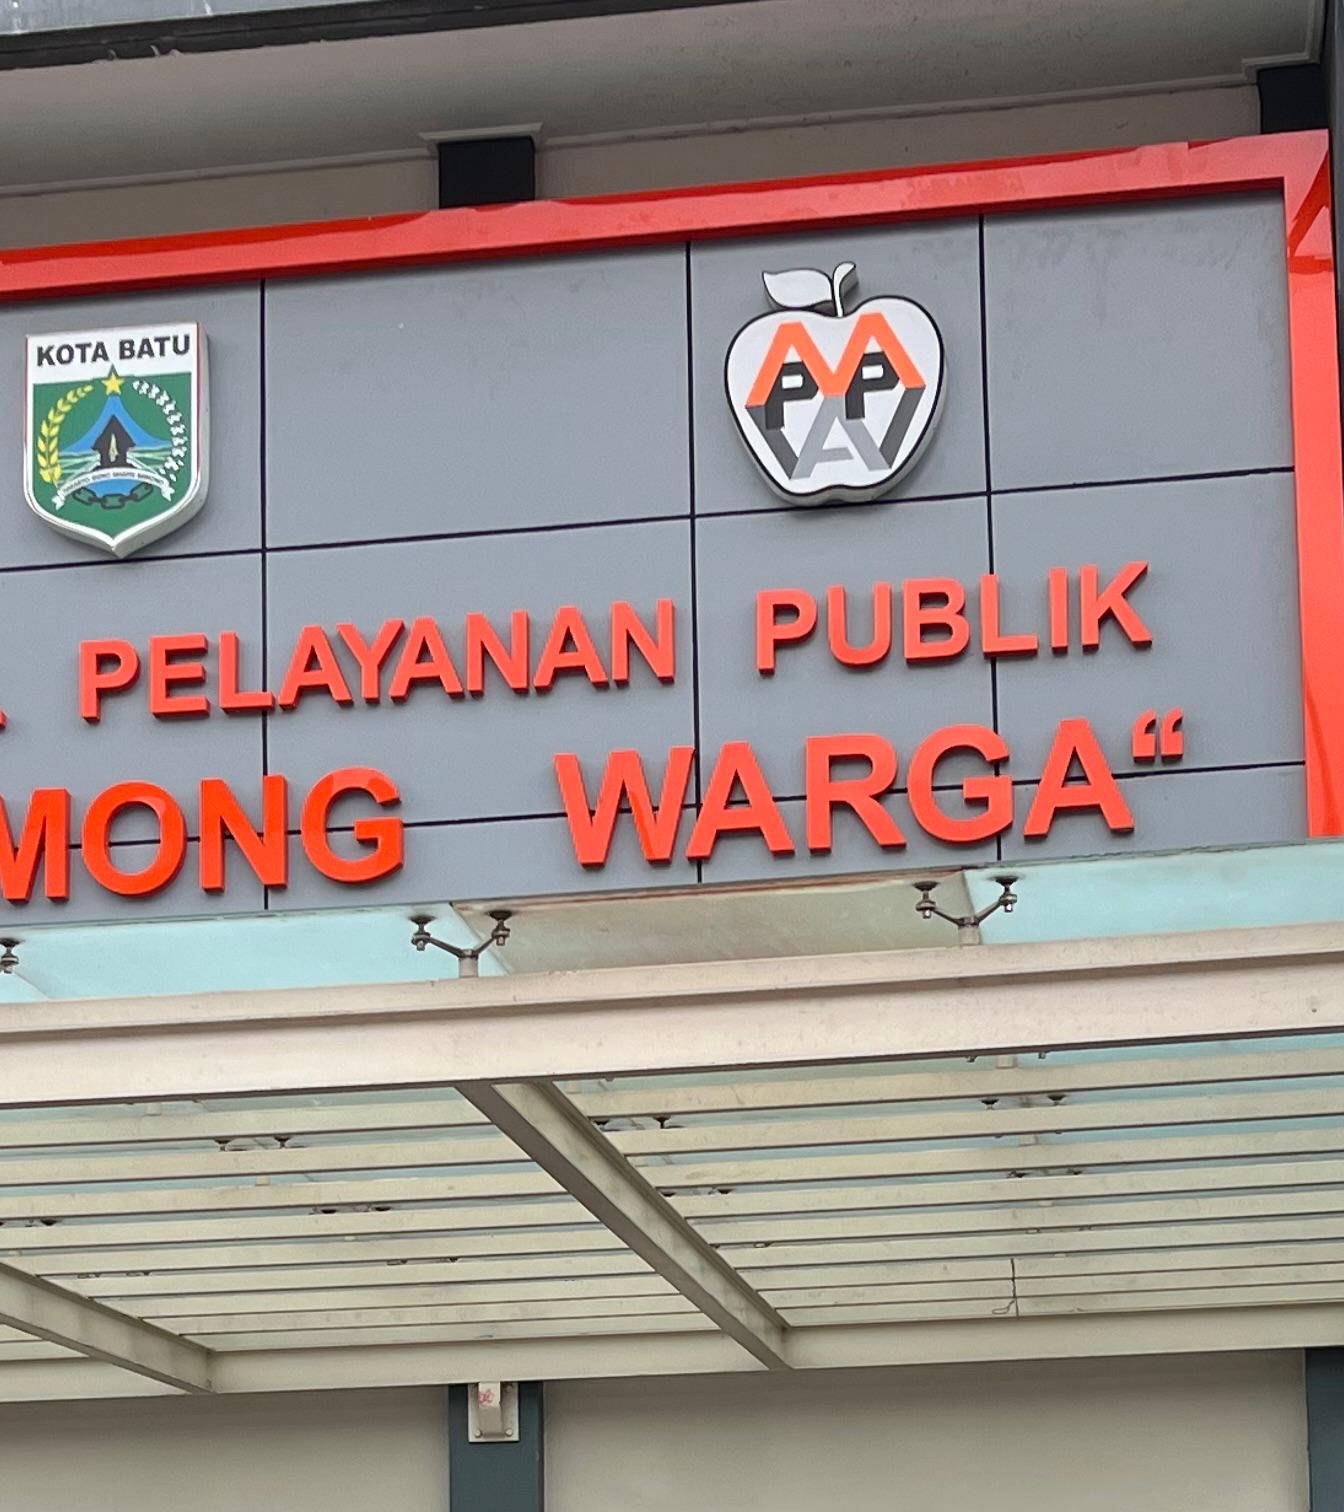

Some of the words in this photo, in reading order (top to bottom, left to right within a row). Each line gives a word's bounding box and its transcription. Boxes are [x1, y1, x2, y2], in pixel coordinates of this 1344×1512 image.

[36, 341, 110, 367] KOTA
[119, 333, 191, 360] BATU
[78, 597, 675, 724] PELAYANAN
[755, 560, 1153, 676] PUBLIK
